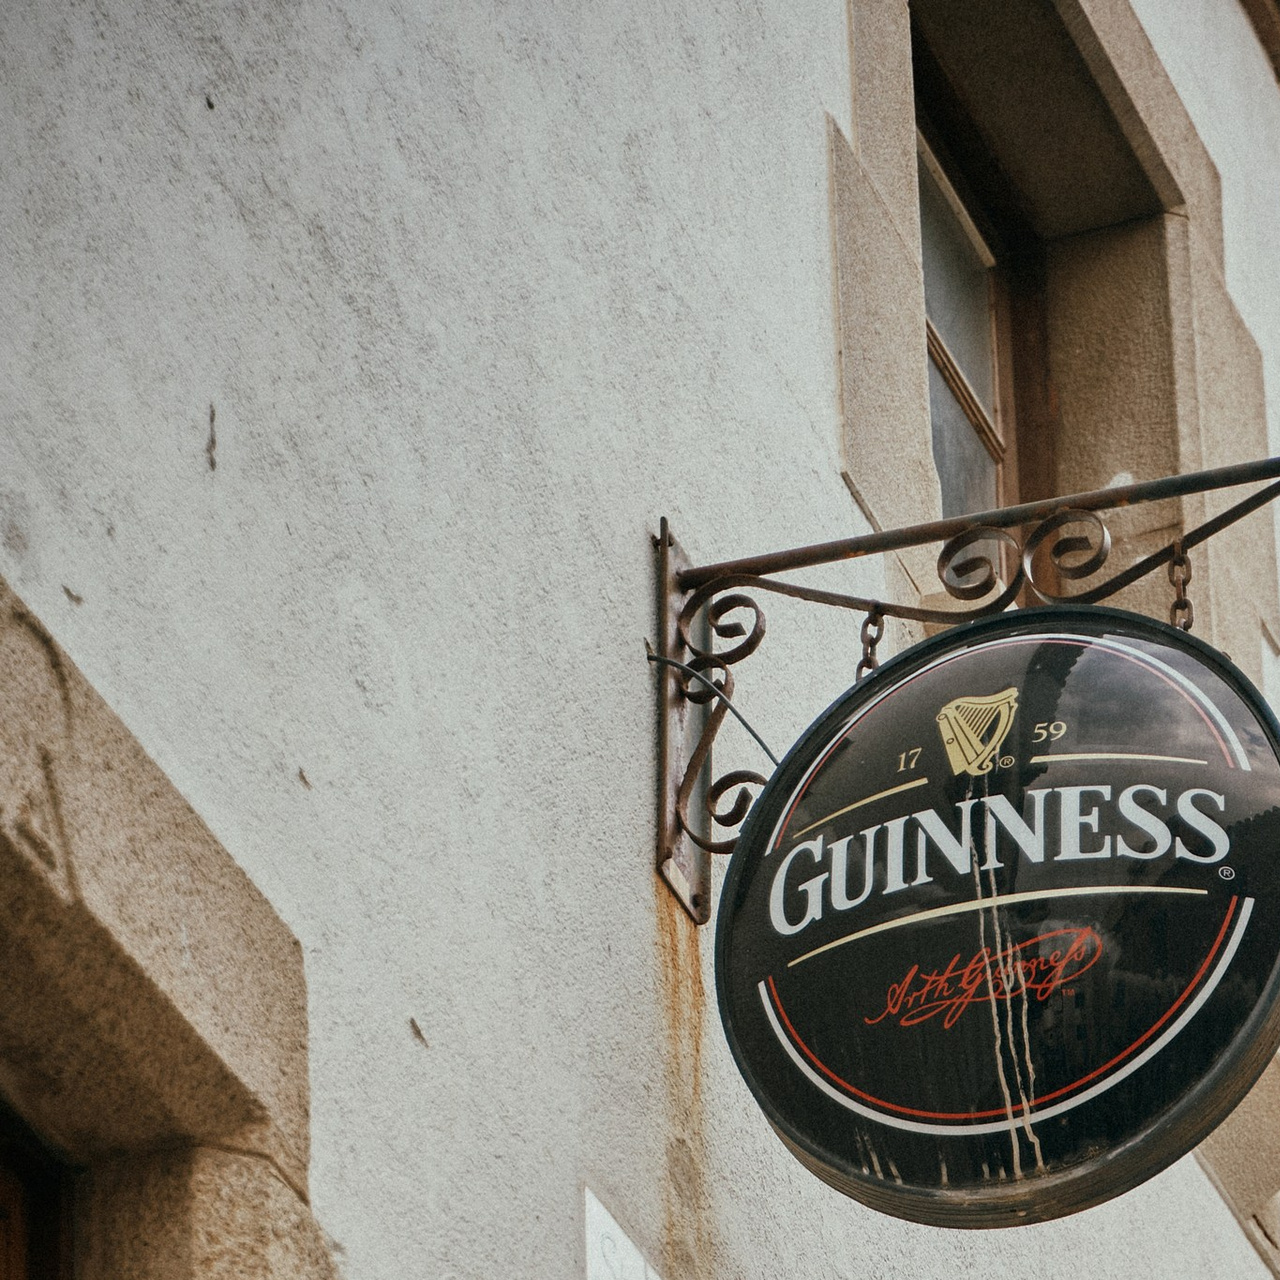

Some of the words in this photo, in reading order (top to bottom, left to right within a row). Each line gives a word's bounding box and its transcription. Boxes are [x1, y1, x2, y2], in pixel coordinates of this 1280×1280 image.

[897, 747, 922, 772] 17
[1032, 721, 1067, 743] 59
[768, 785, 1232, 936] GUINNESS
